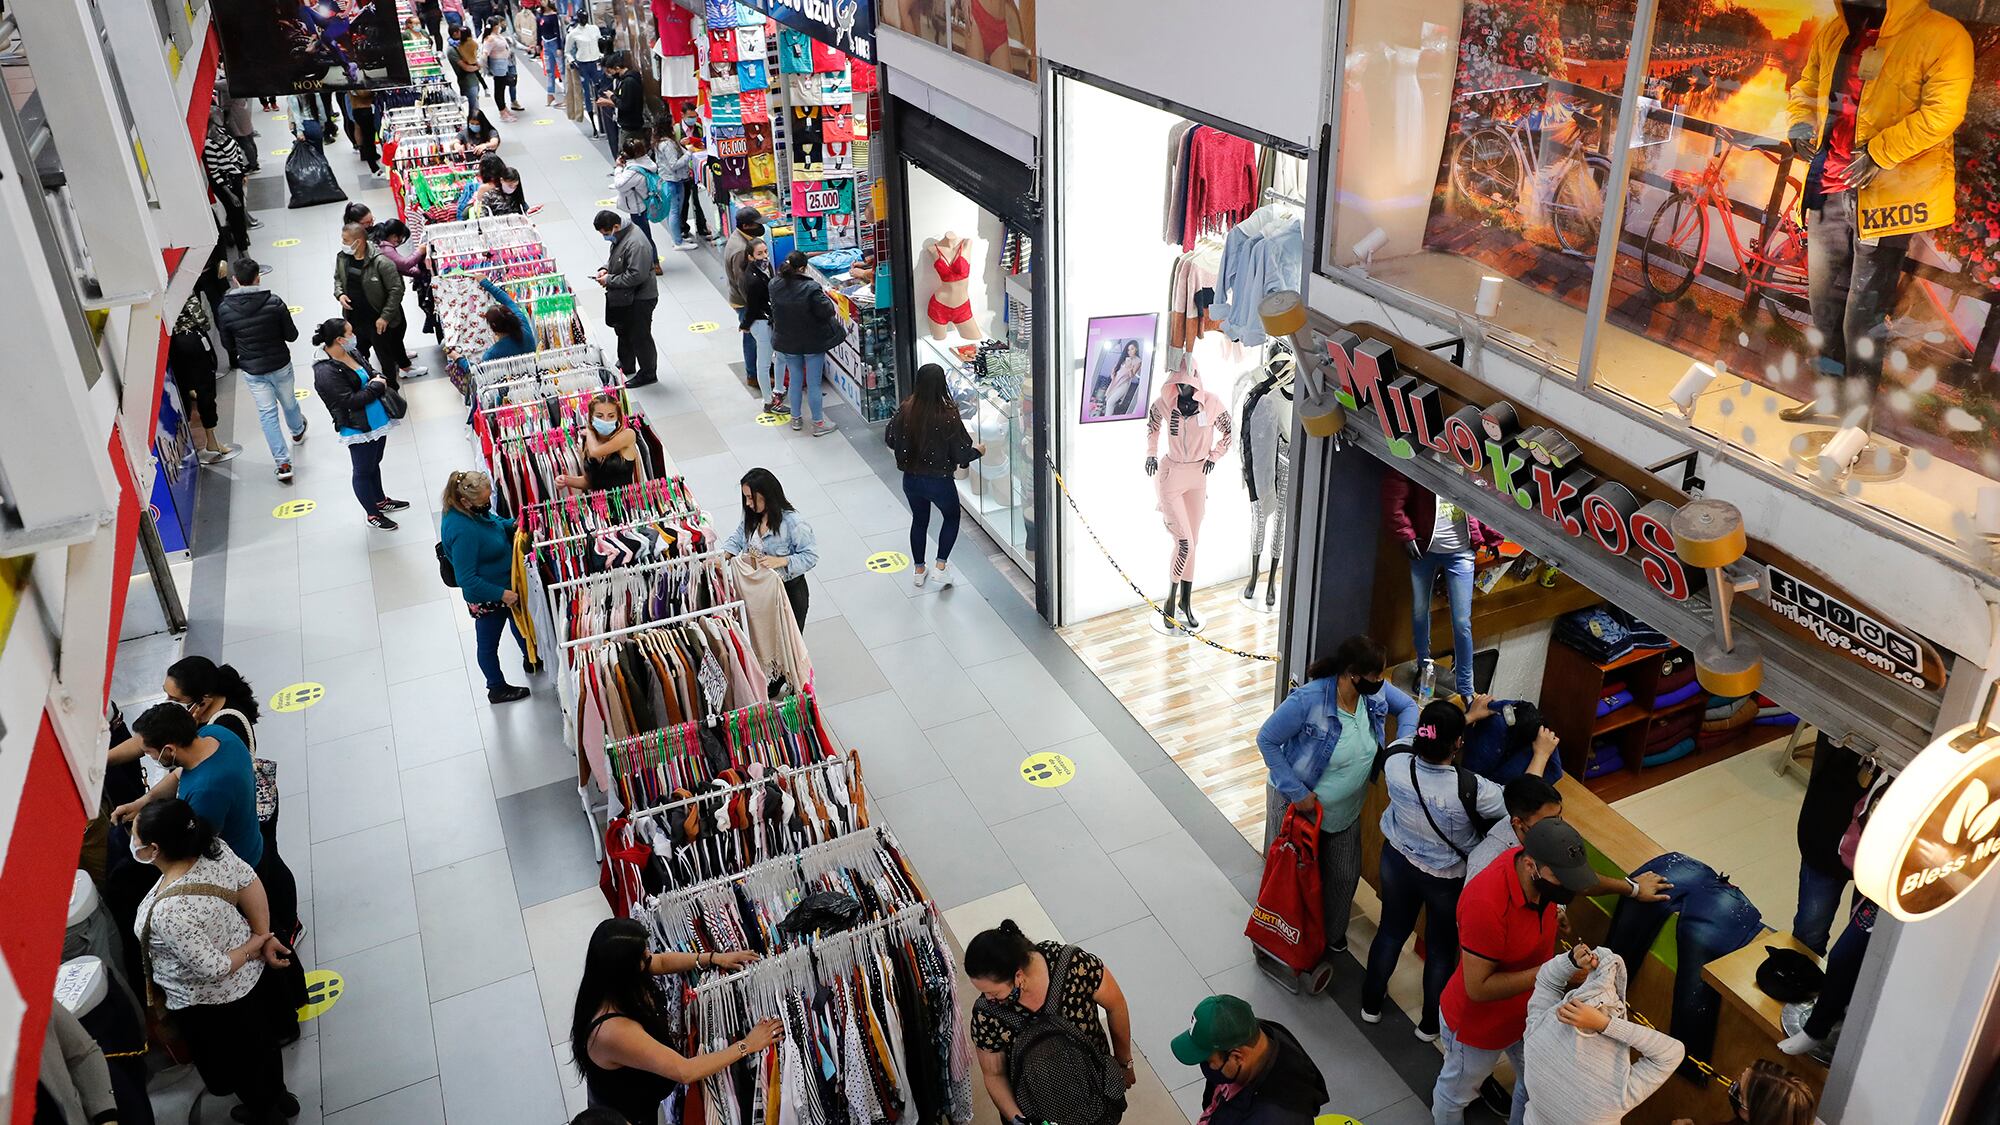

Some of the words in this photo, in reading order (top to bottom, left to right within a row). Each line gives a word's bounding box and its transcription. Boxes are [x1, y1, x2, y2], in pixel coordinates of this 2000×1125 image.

[293, 80, 323, 89] NOW
[809, 192, 838, 209] 25.000
[1862, 202, 1928, 229] KKOS
[1771, 598, 1926, 690] milokkos.com.co
[1900, 855, 1968, 897] Bless
[1253, 907, 1296, 941] SURTIMAX
